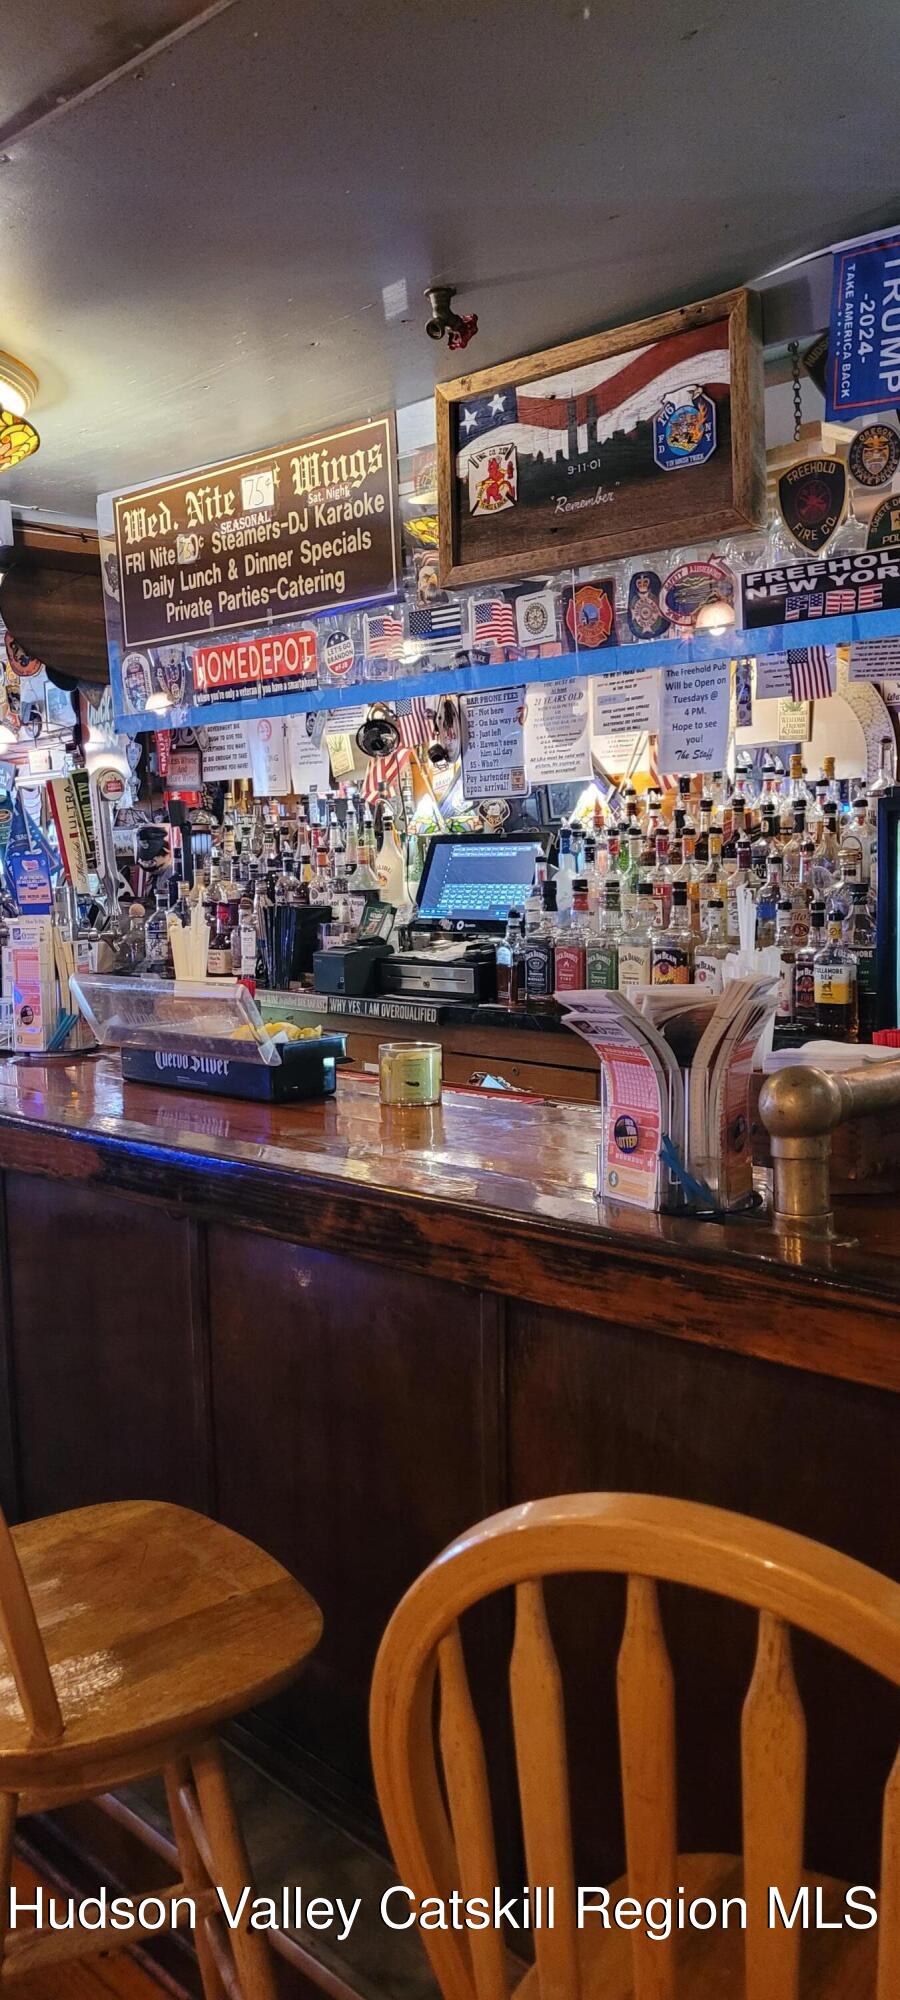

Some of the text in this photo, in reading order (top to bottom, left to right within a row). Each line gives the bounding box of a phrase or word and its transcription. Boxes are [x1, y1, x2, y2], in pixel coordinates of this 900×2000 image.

[840, 263, 856, 399] TAKE AMERICA BACK
[657, 402, 675, 427] 176
[567, 458, 601, 476] 9-11-01
[786, 461, 836, 485] FREEHOLD
[122, 443, 383, 546] Wed. Nite Wings
[308, 491, 324, 505] Sat.
[220, 510, 272, 535] SEASONAL
[791, 515, 837, 540] FIRE CO.
[125, 551, 146, 576] FRI
[149, 546, 176, 570] Nite
[315, 491, 385, 529] Karaoke
[882, 533, 900, 545] POL
[142, 530, 373, 600] Daily Lunch & Dinner Specials
[746, 552, 900, 586] FREEHOL
[744, 564, 900, 601] NEW YOR
[166, 567, 346, 624] Private Parties-Catering
[784, 583, 884, 621] FIRE
[666, 663, 727, 678] The Freehold Pub
[665, 677, 727, 691] Will be Open on
[466, 691, 519, 705] BAR PHONE FEES
[543, 693, 566, 704] YEARS
[567, 691, 584, 701] OLD
[673, 690, 718, 704] Tuesdays @
[479, 708, 490, 716] Not
[491, 706, 504, 715] here
[684, 706, 707, 716] 4 PM.
[489, 717, 499, 725] his
[500, 717, 511, 726] way
[672, 720, 718, 733] Hope to see
[480, 740, 503, 749] Haven't
[503, 738, 518, 746] seen
[686, 735, 704, 745] you!
[480, 748, 513, 758] him all day
[675, 748, 714, 761] The Staff
[481, 759, 499, 768] Who??
[466, 772, 510, 784] Pay bartender
[485, 781, 509, 792] arrival!
[64, 784, 78, 830] ULTRA
[701, 961, 716, 975] BEAM
[329, 997, 347, 1013] WHY
[364, 1002, 368, 1014] I
[368, 1002, 380, 1016] AM
[381, 1003, 437, 1023] OVERQUALIFIED
[154, 1051, 189, 1071] Cuervo
